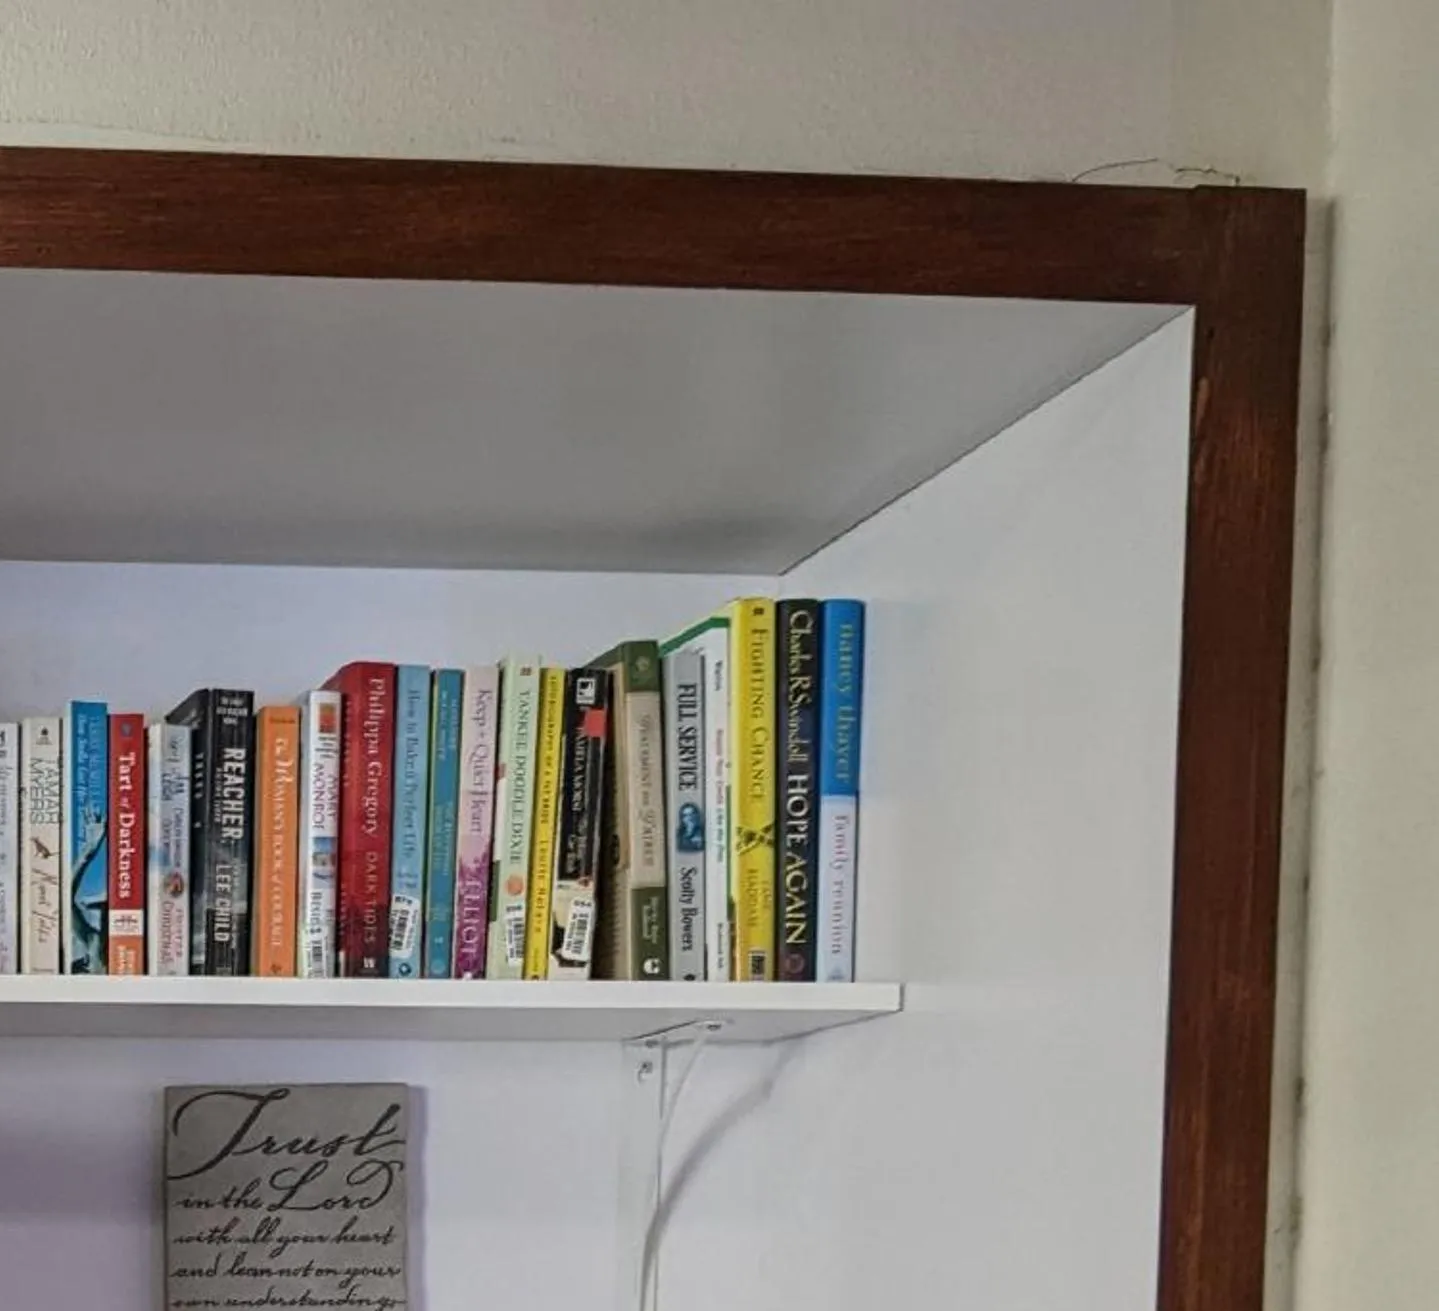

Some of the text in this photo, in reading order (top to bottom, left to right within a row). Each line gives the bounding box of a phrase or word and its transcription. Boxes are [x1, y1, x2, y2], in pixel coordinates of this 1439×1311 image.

[407, 689, 419, 719] How
[750, 627, 769, 803] FIGHTING CHANCE
[787, 610, 814, 762] Charles Swindoll
[361, 678, 385, 837] Philippa Gregory
[405, 737, 419, 765] Bake
[406, 722, 419, 735] to
[469, 689, 491, 834] Keep Quiet Heart
[677, 683, 698, 791] FULL SERVICE
[30, 757, 45, 824] MYERS
[119, 752, 136, 791] Tart
[313, 763, 326, 830] MONROE
[327, 773, 339, 818] MARY
[509, 689, 530, 865] YANKEE DOODLE DIXIE
[404, 783, 417, 828] Perfect
[540, 799, 551, 824] BRIDE
[119, 812, 136, 899] Darkness
[403, 833, 417, 859] Life
[785, 773, 808, 944] HOPE AGAIN
[214, 864, 232, 942] LEE CHILD
[365, 851, 378, 943] DARK TIDES
[534, 840, 548, 933] Laurie Notaro
[679, 867, 696, 951] Scotty Bowers
[746, 868, 759, 927] HADDAM
[167, 1088, 406, 1180] Trust
[175, 1159, 405, 1212] in the Lord
[170, 1251, 401, 1289] and lean not on your
[172, 1215, 395, 1259] with all your heart
